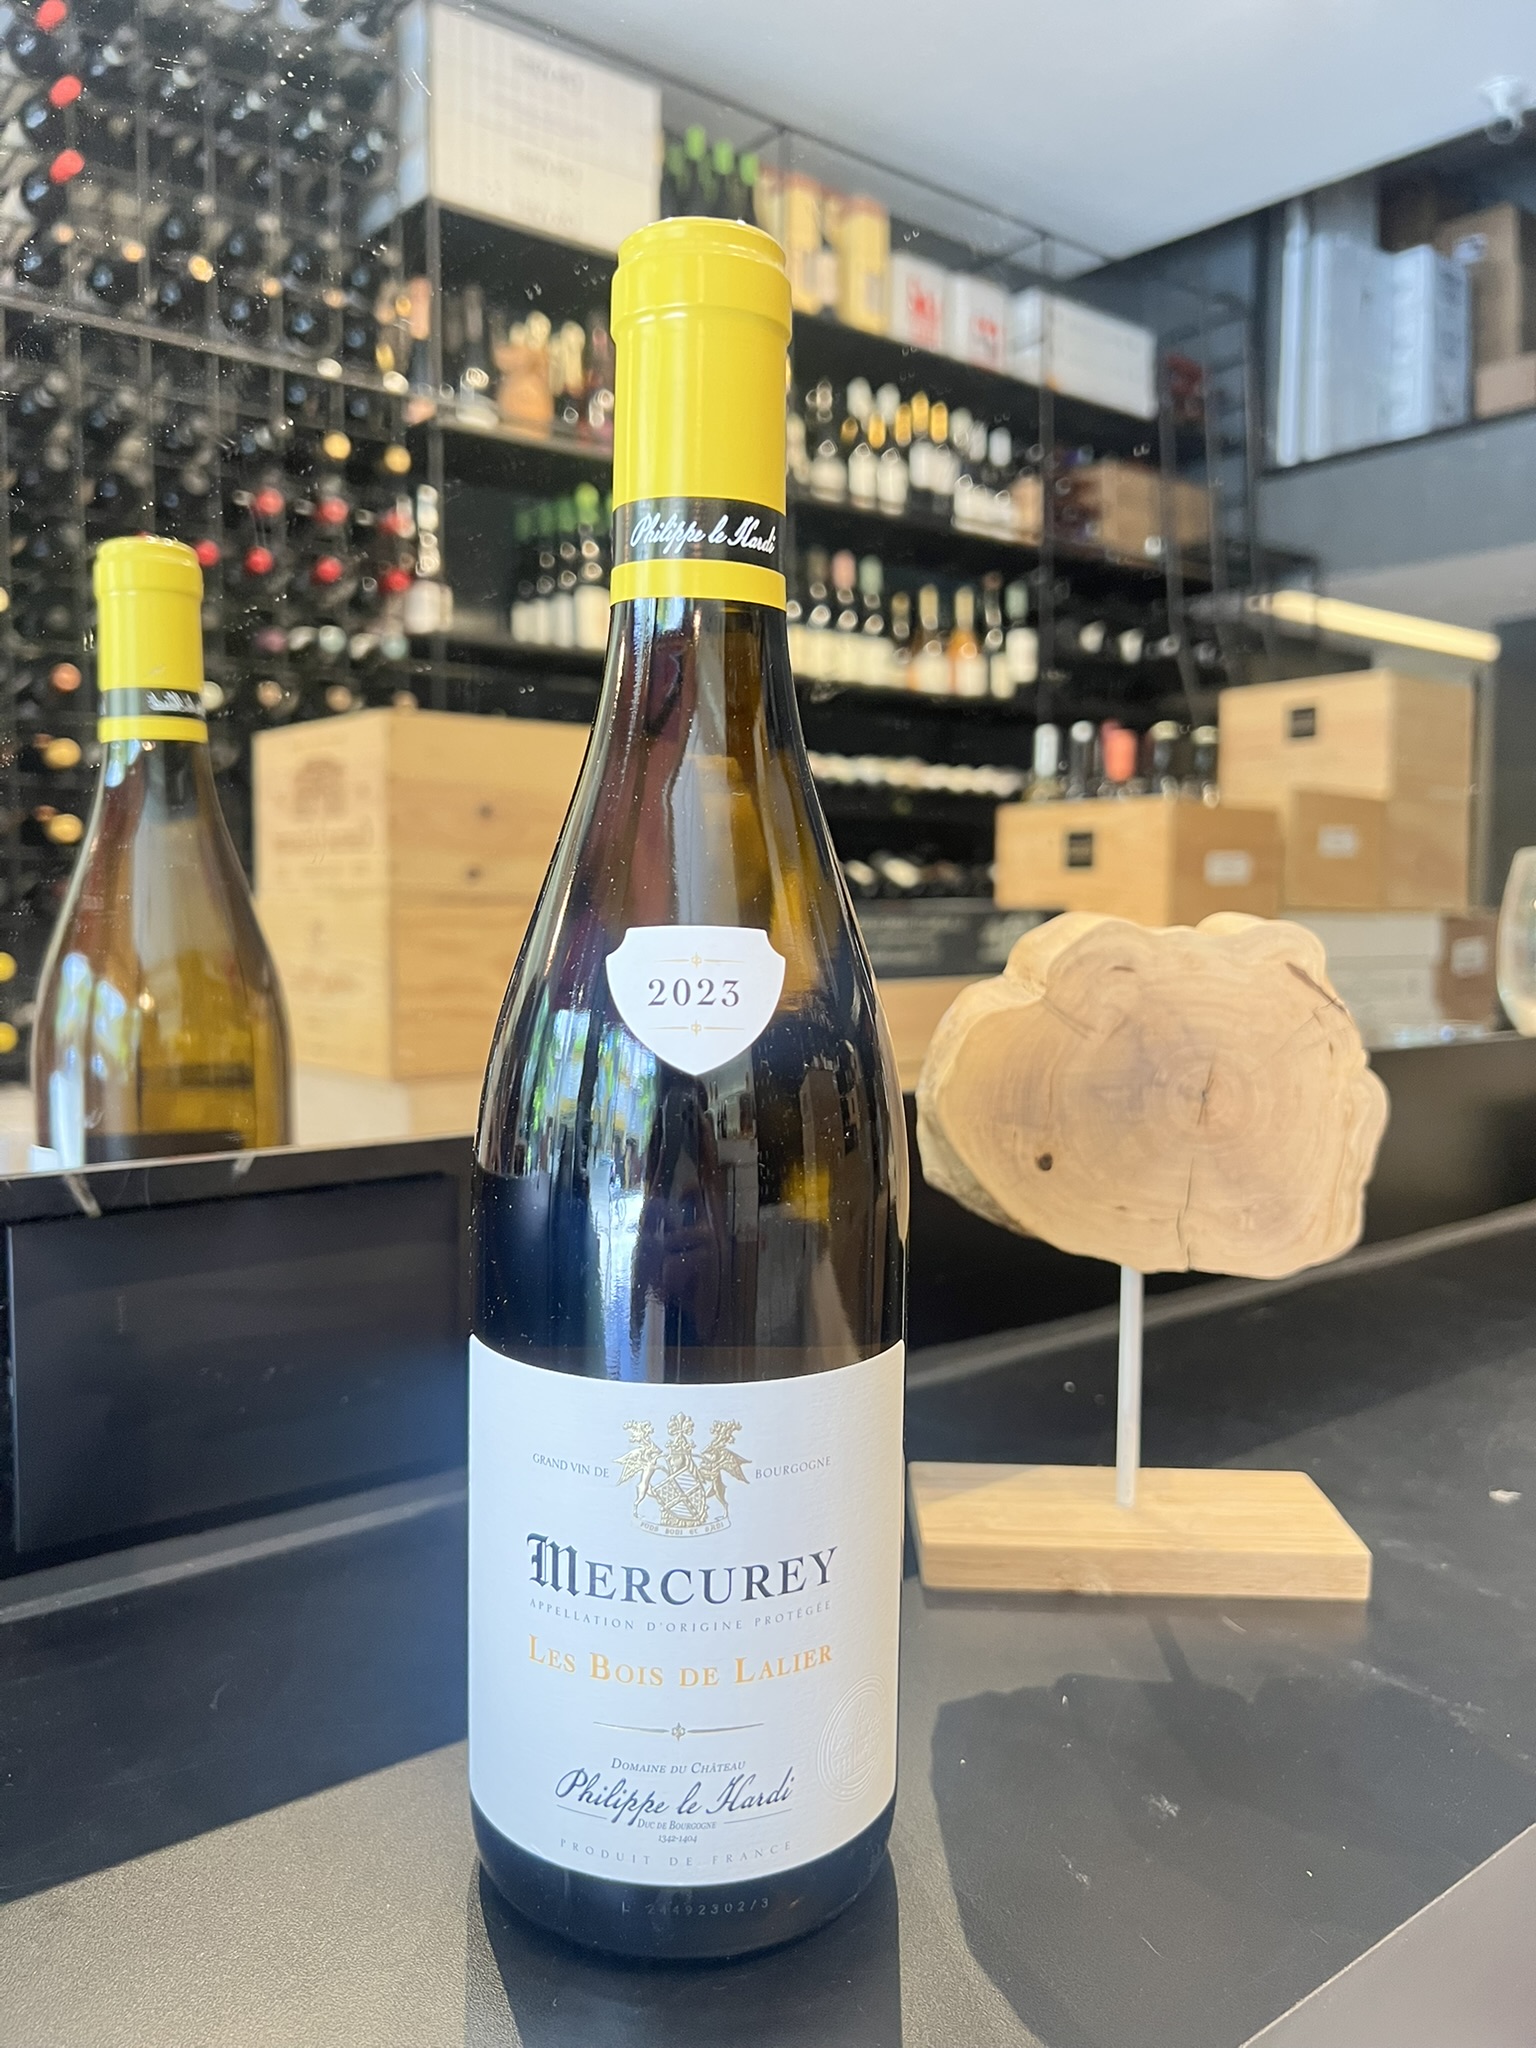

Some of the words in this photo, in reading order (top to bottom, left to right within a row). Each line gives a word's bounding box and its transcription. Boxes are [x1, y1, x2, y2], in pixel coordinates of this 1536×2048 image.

[630, 512, 706, 555] Philippe
[707, 514, 728, 544] le
[726, 515, 777, 555] Hardi
[647, 978, 740, 1007] 2023
[532, 1453, 568, 1471] GRAND
[570, 1462, 590, 1475] VIN
[594, 1466, 610, 1478] DE
[755, 1455, 832, 1480] BOURGOGNE
[526, 1532, 838, 1606] MERCUREY
[530, 1598, 634, 1630] APPELLATION
[647, 1619, 742, 1633] D'ORIGINE
[754, 1600, 831, 1627] PROTÉGÉE
[529, 1634, 576, 1673] LES
[590, 1652, 664, 1687] BOIS
[680, 1667, 720, 1687] DE
[735, 1644, 833, 1684] LALIER
[611, 1757, 667, 1774] DOMAINE
[670, 1765, 687, 1774] DU
[691, 1761, 746, 1774] CHÂTEAU
[555, 1767, 670, 1826] Philippe
[677, 1781, 703, 1815] le
[705, 1766, 795, 1815] Hardi
[637, 1818, 655, 1829] DUC
[656, 1822, 667, 1830] DE
[669, 1820, 717, 1830] BOURGOGNE
[560, 1838, 651, 1865] PRODUIT
[669, 1857, 693, 1866] DE
[712, 1841, 791, 1865] FRANCE
[658, 1834, 697, 1844] 1342-1404
